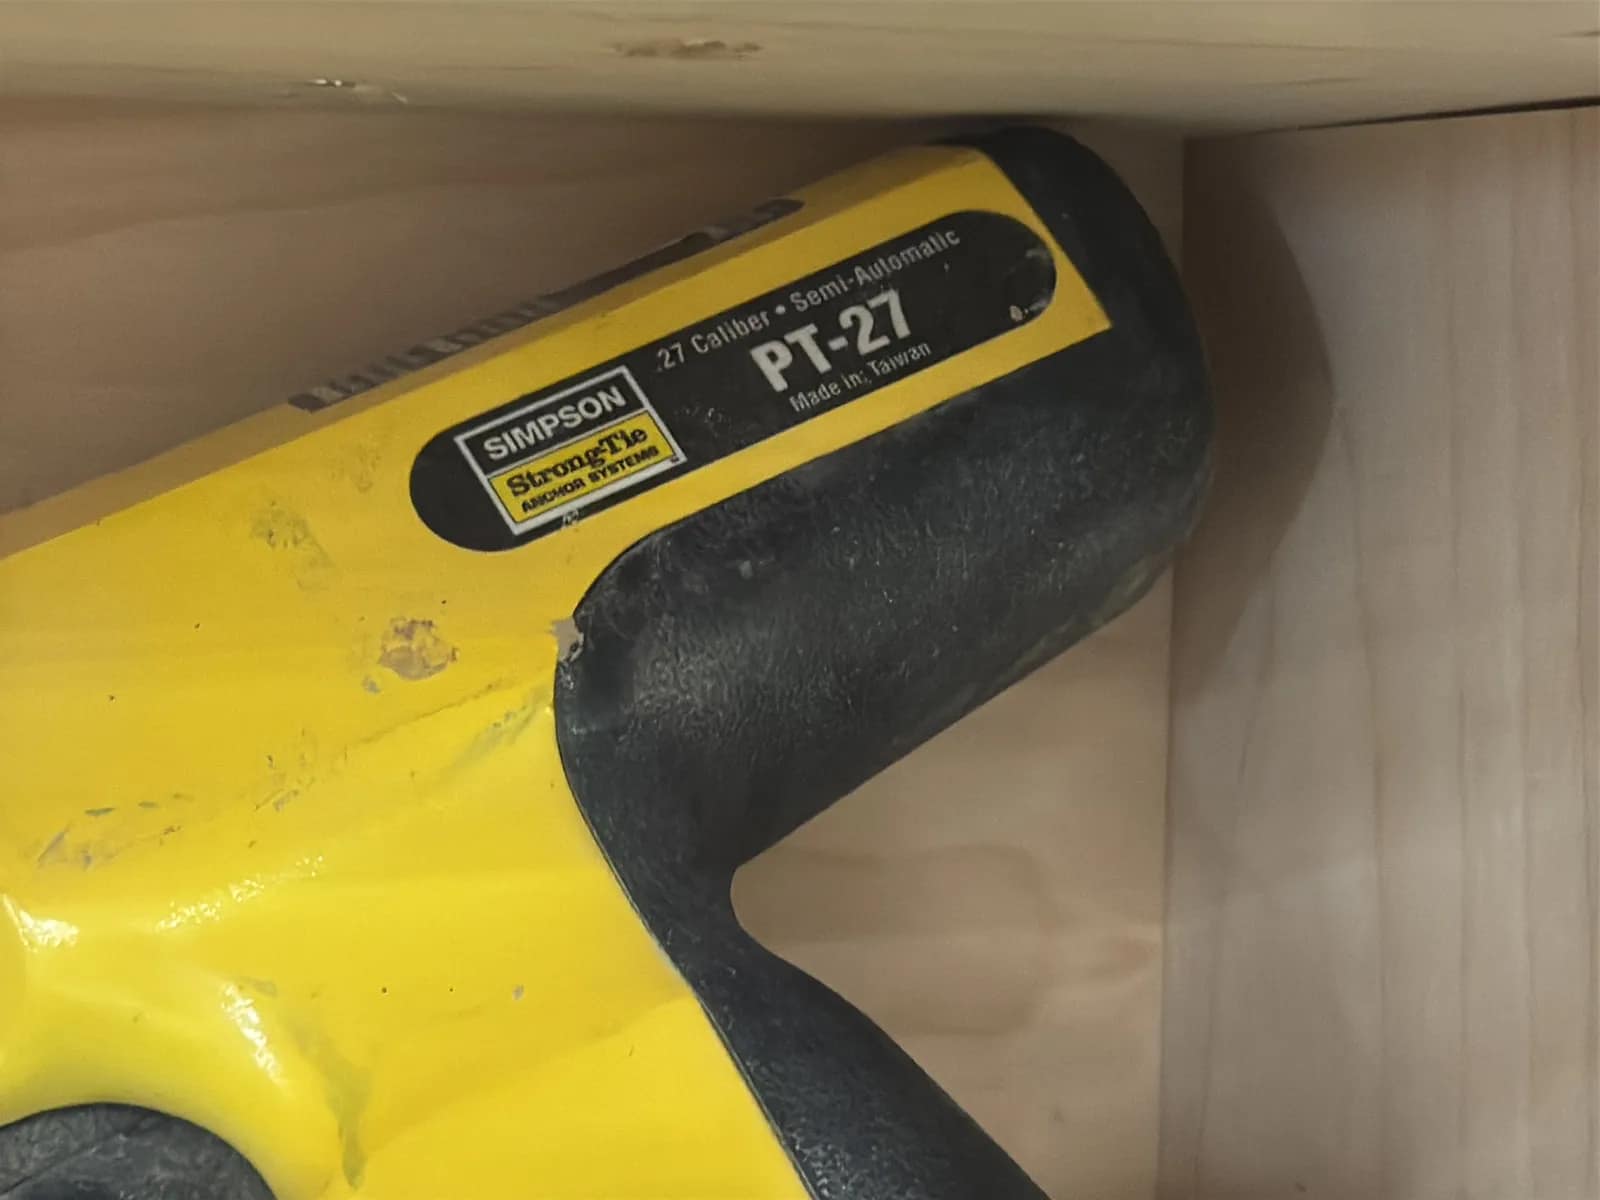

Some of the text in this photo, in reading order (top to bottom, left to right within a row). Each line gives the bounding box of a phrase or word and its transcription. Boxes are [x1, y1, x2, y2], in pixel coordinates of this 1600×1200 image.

[690, 306, 770, 355] Caliber
[789, 229, 961, 313] Semi-Automatic
[749, 290, 912, 393] PT-27
[789, 379, 841, 413] Made
[868, 341, 931, 376] Taiwan
[484, 386, 627, 461] SIMPSON
[506, 427, 649, 497] Strong-Tie
[520, 445, 660, 513] ANCHOR SYSTEMS
